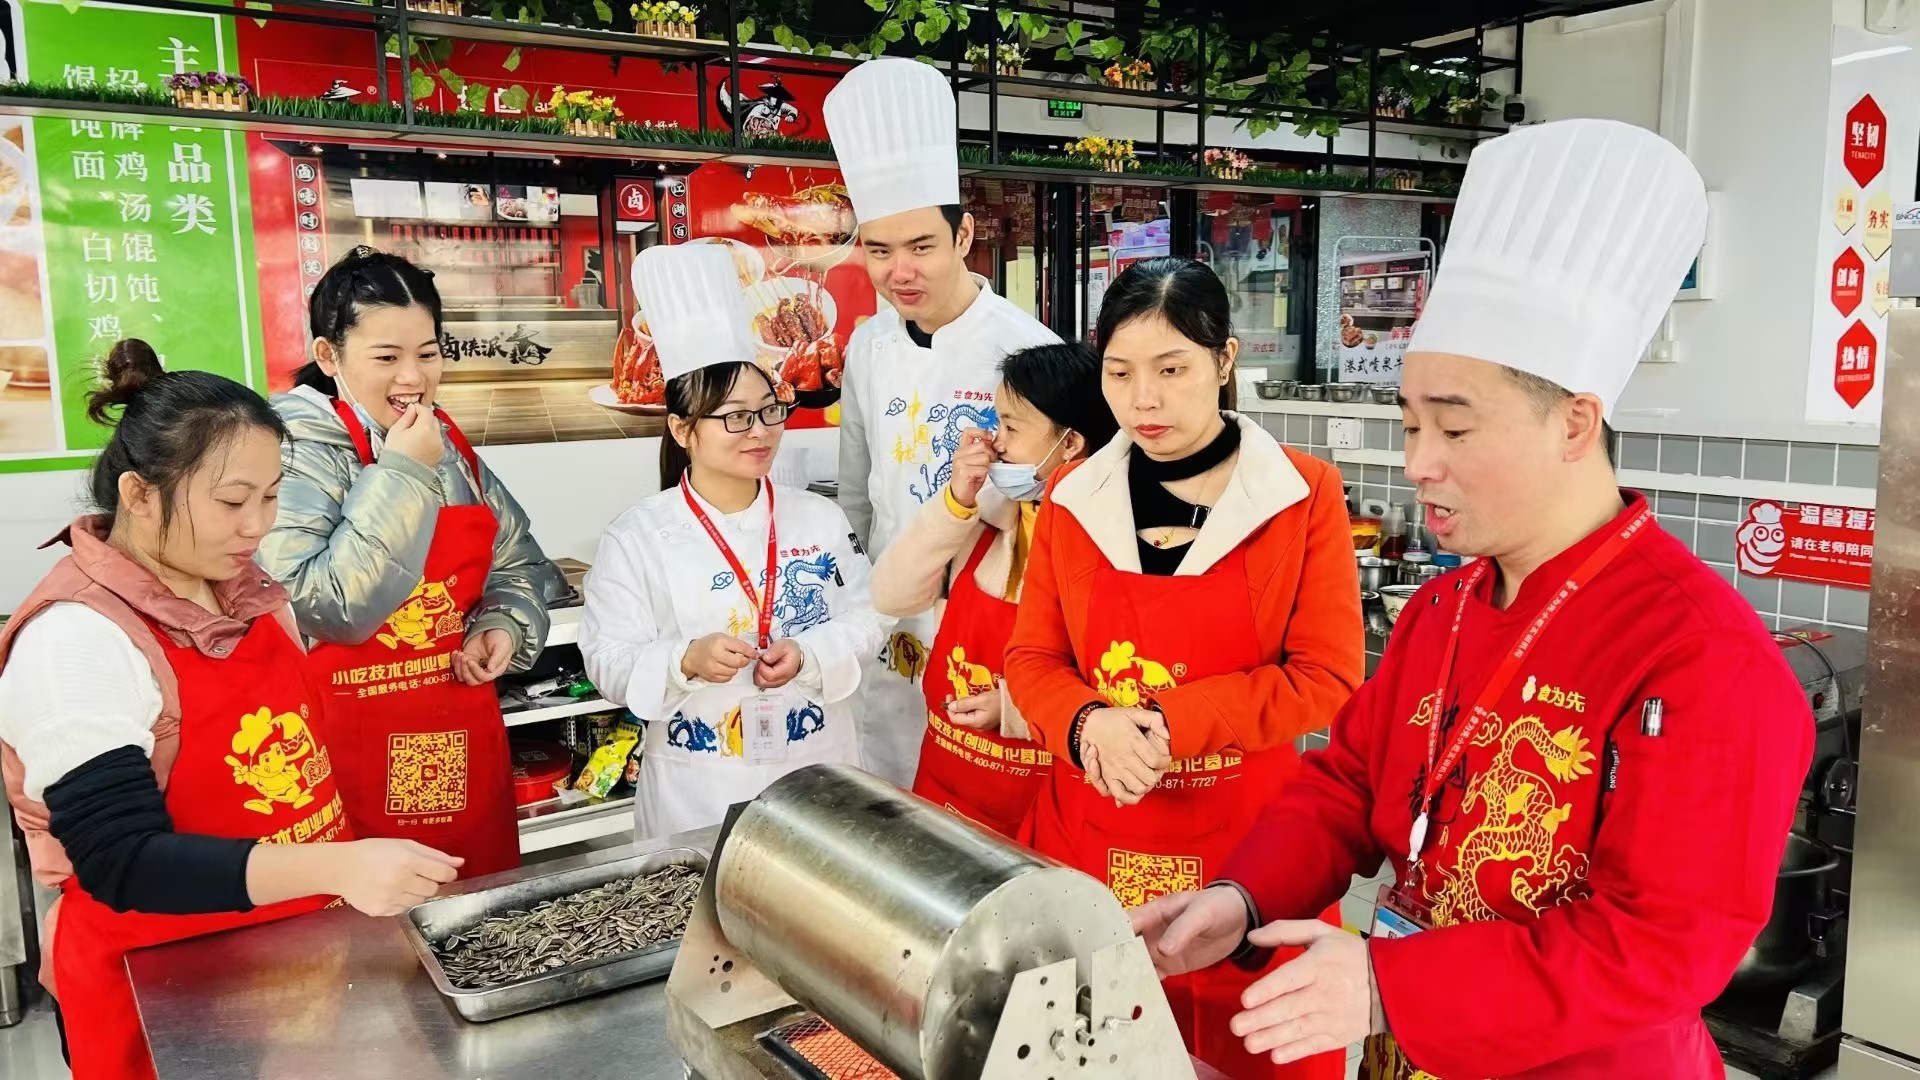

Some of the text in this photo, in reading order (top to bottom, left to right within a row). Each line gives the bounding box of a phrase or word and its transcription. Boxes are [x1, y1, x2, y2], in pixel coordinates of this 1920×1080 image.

[158, 36, 218, 235] 主品类
[1850, 121, 1880, 149] 坚韧
[1851, 151, 1876, 160] TENACITY
[627, 187, 645, 211] 卤
[1867, 210, 1889, 229] 务实
[1836, 267, 1859, 287] 创新
[442, 331, 508, 362] 卤侠派
[1841, 345, 1870, 370] 热情
[964, 390, 995, 402] 食为先
[1790, 537, 1874, 558] 请在老师陪同
[1537, 683, 1586, 713] 食为先
[973, 756, 1032, 777] 400-871-7727
